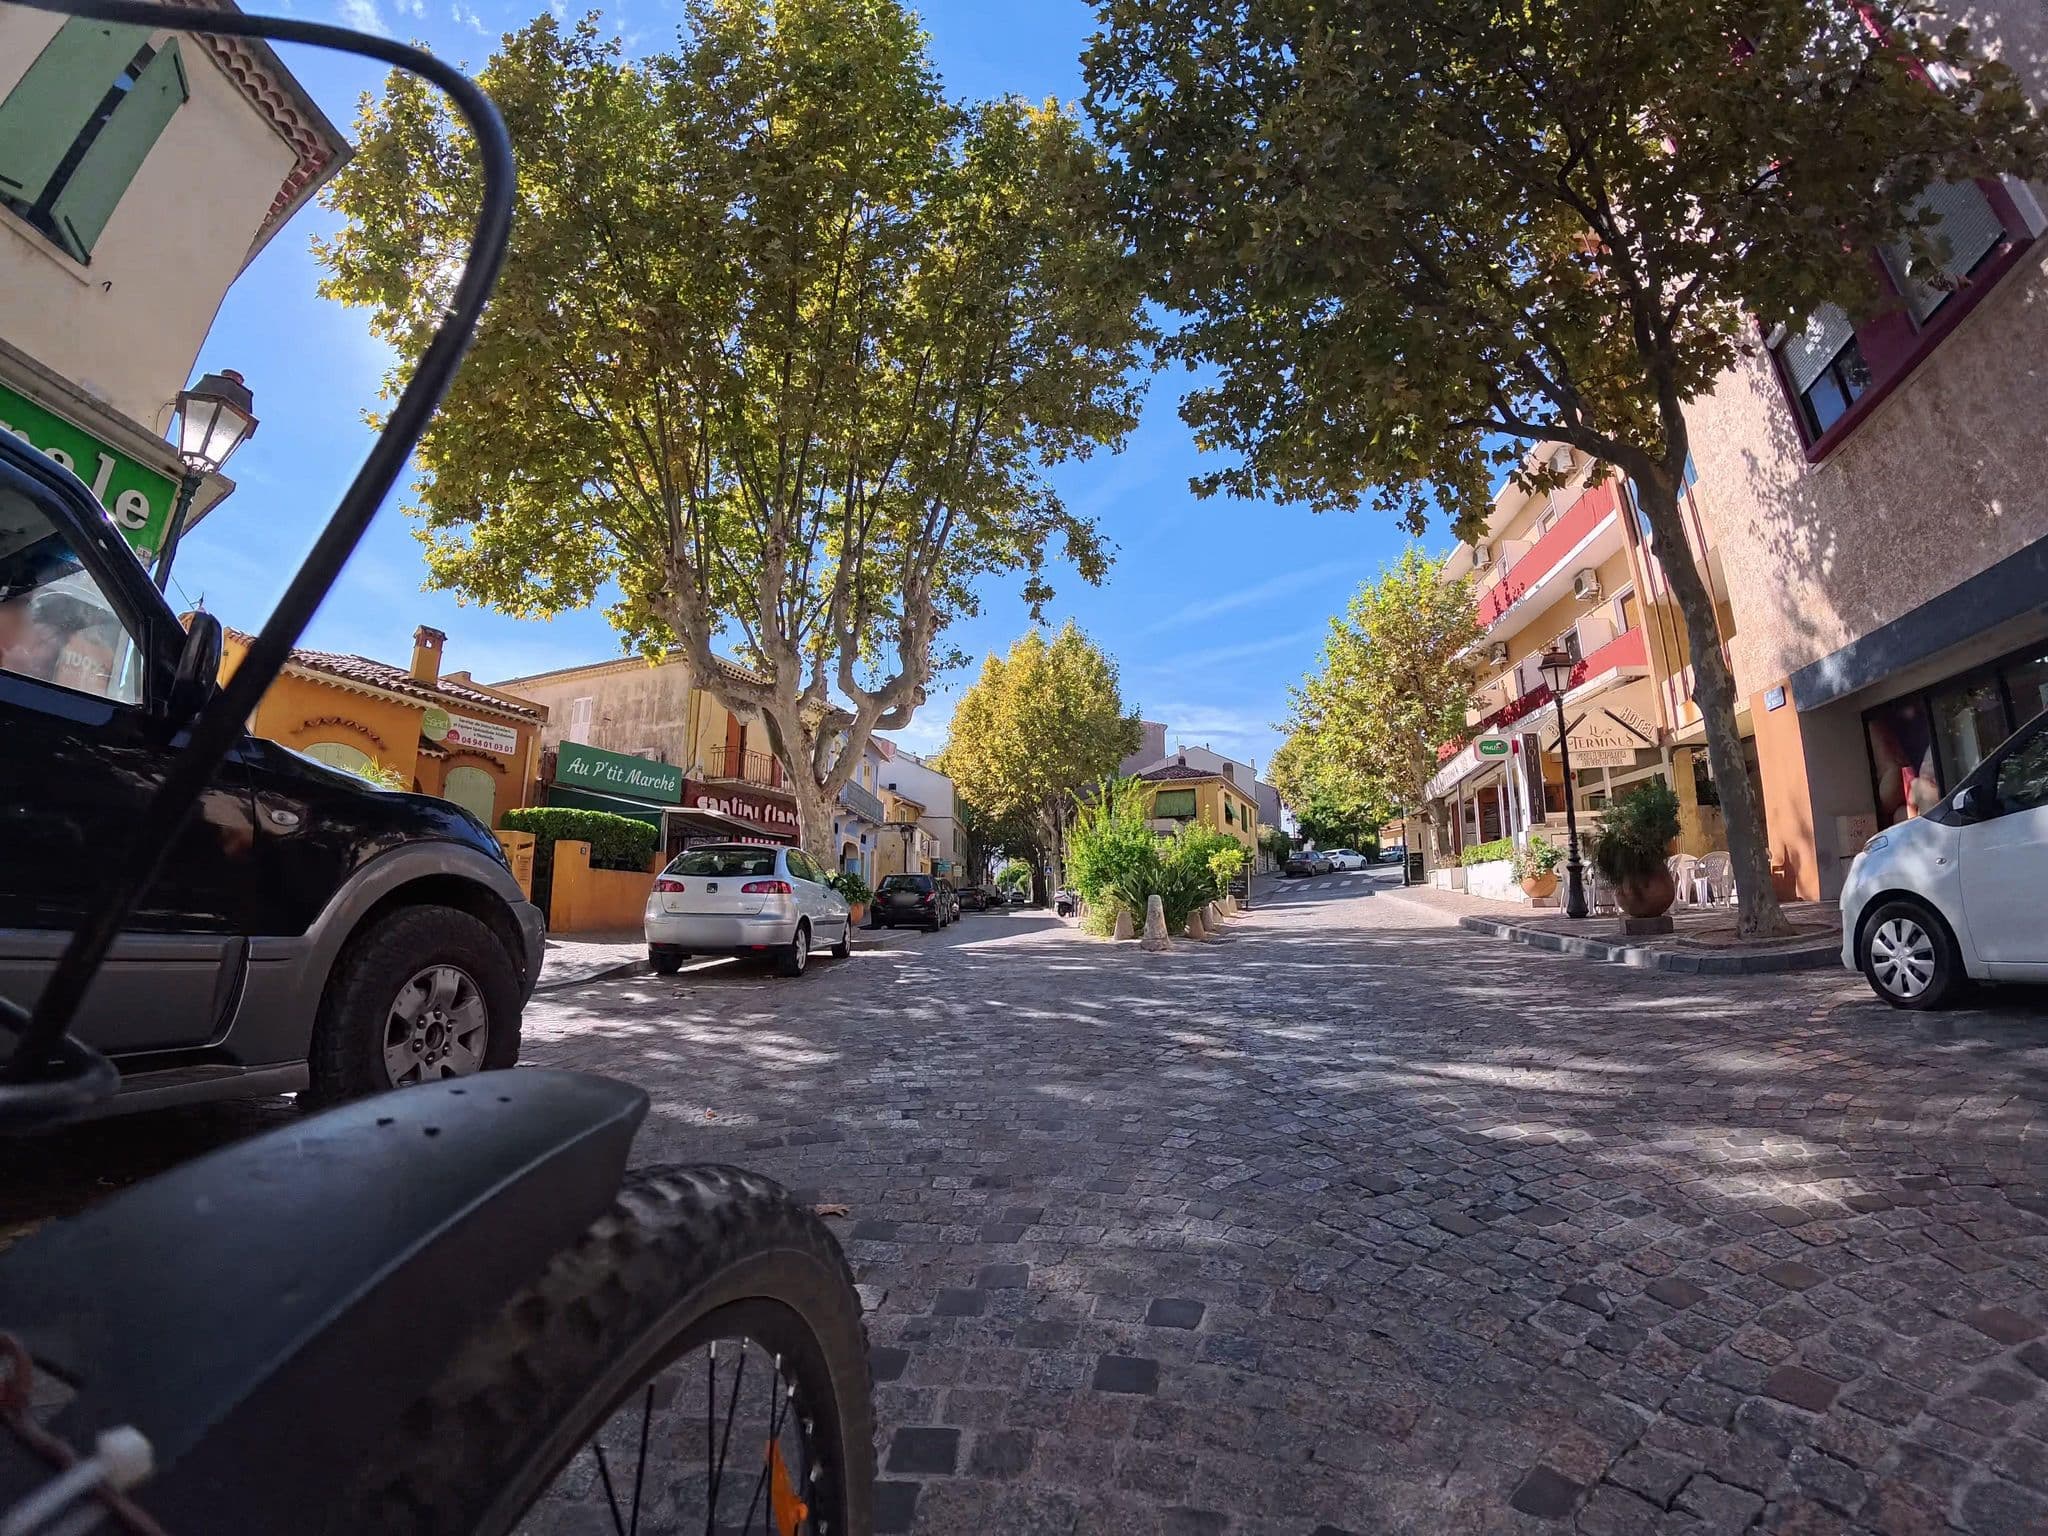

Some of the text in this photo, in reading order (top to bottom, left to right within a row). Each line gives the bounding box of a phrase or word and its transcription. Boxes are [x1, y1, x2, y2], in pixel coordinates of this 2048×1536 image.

[1568, 733, 1634, 749] TERMINUS
[567, 757, 675, 791] Au P'tit Marché
